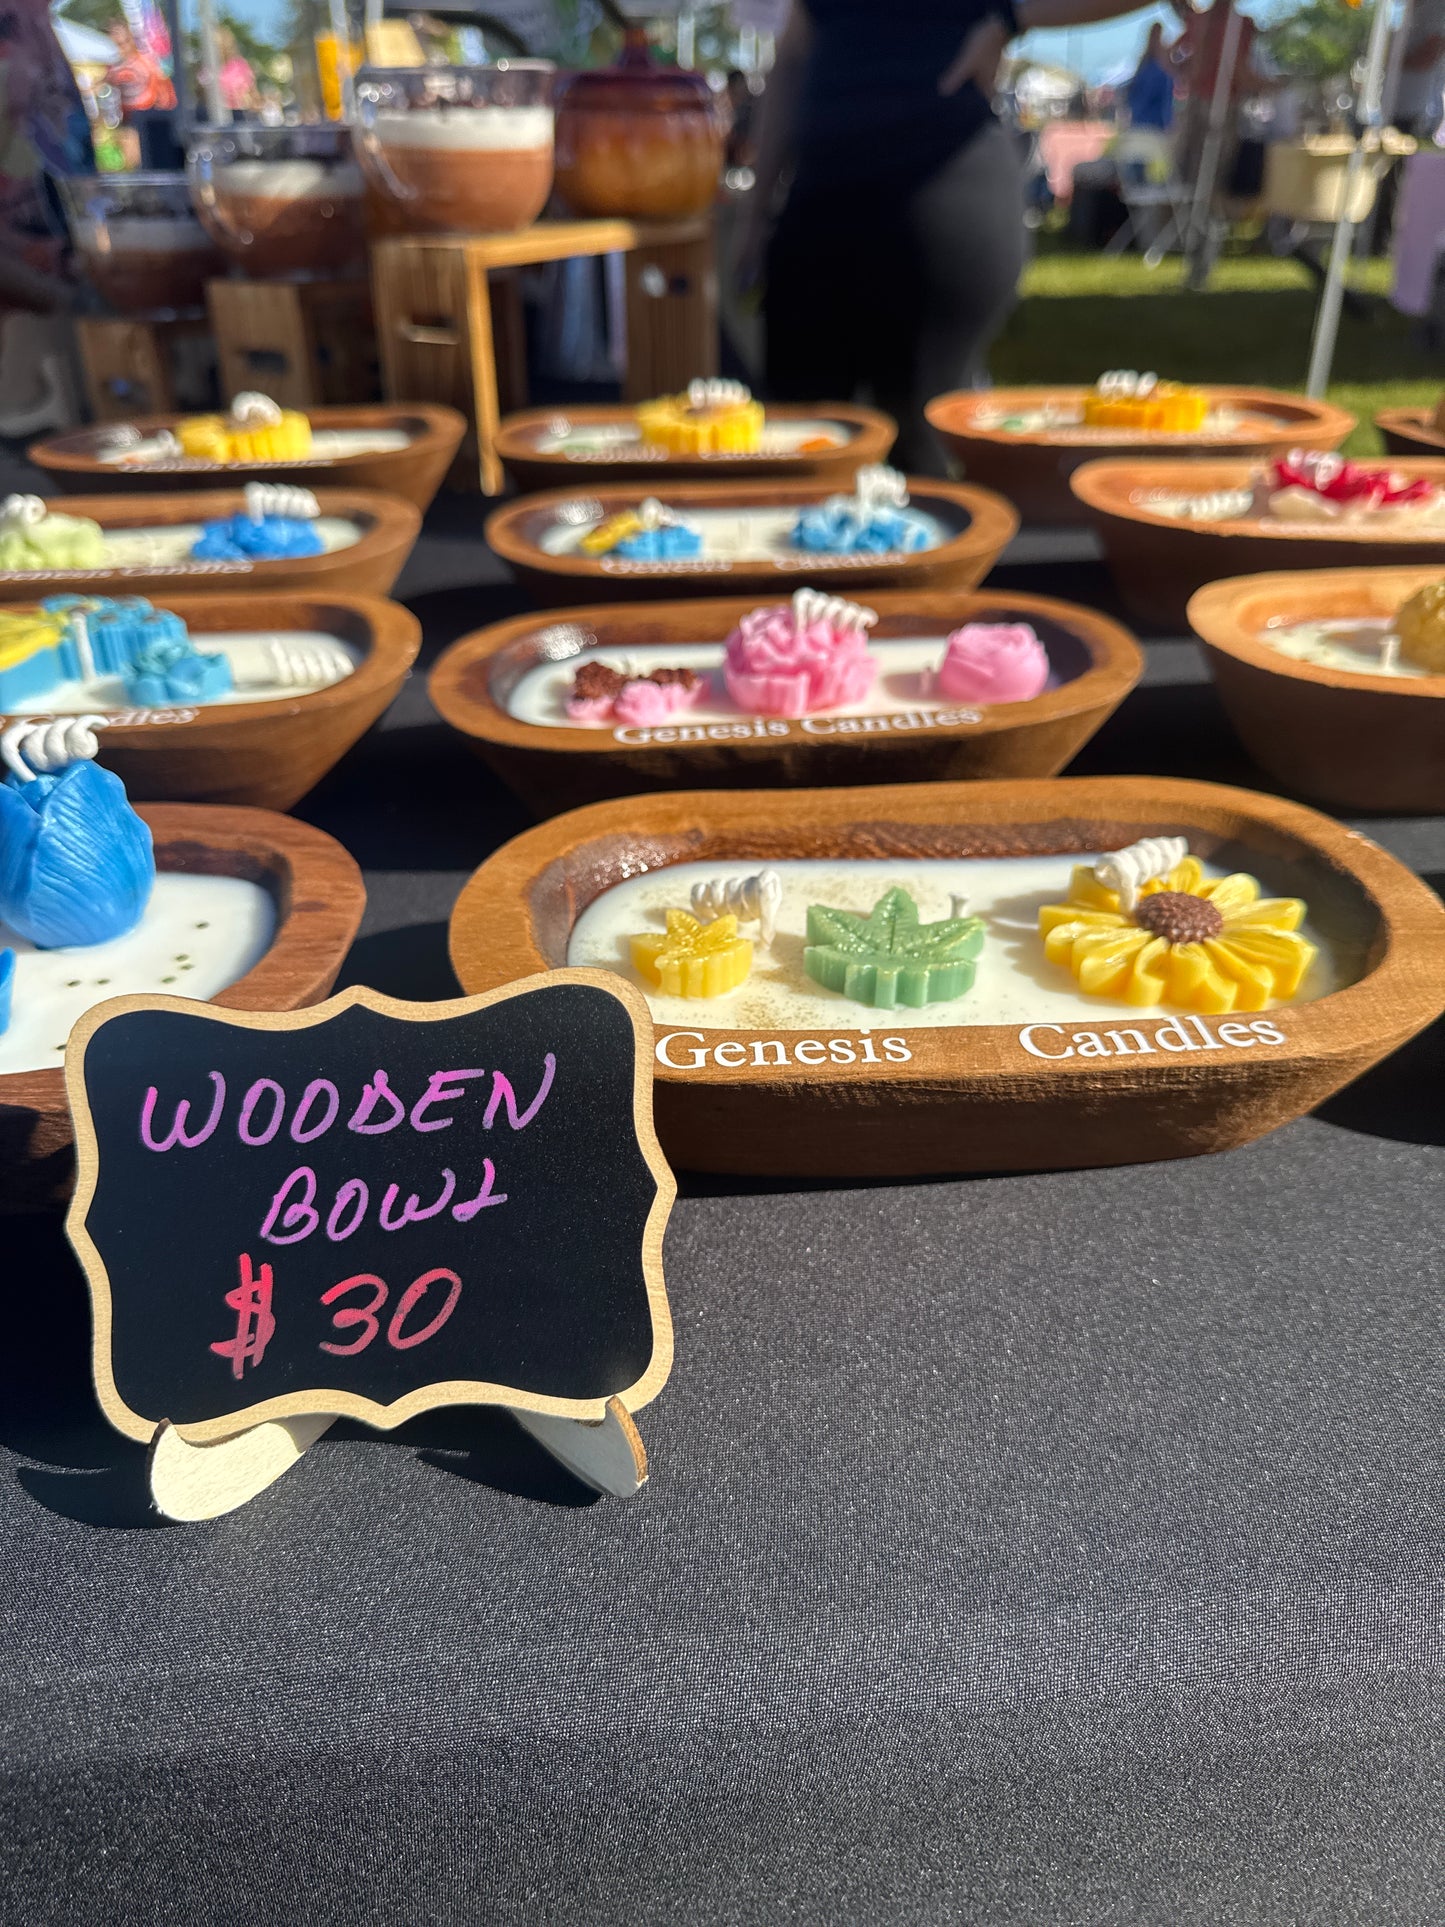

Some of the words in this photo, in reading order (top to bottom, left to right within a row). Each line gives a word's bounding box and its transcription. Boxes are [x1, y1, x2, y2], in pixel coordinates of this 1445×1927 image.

[613, 716, 790, 745] Genesis
[800, 707, 983, 735] Candles
[655, 1028, 912, 1069] Genesis
[1018, 1015, 1286, 1060] Candles
[141, 1053, 556, 1152] WOODEN
[261, 1158, 507, 1244] BOWL
